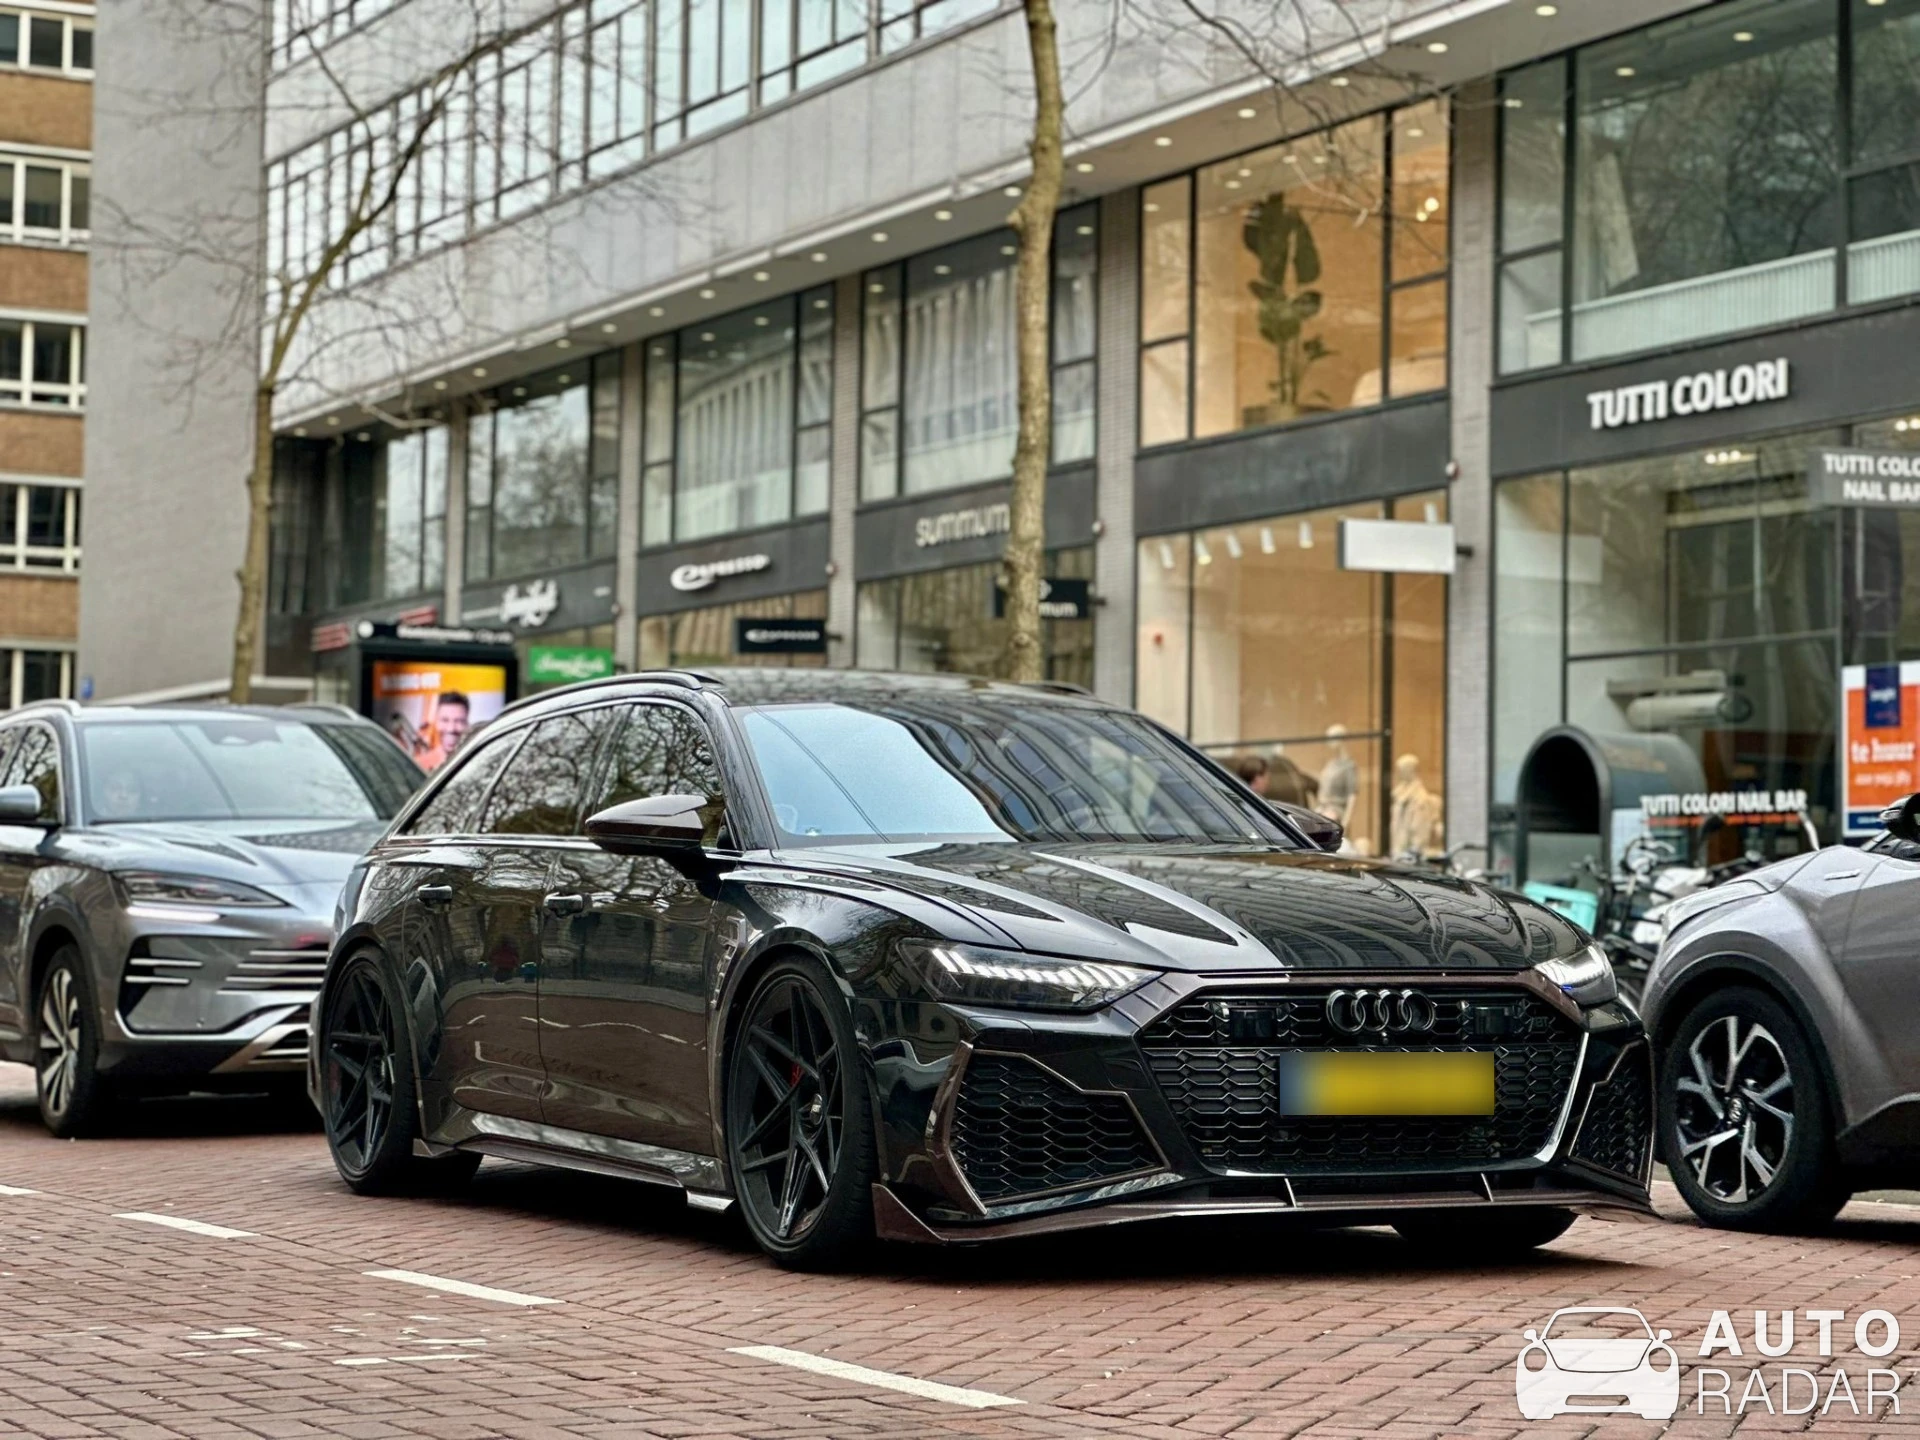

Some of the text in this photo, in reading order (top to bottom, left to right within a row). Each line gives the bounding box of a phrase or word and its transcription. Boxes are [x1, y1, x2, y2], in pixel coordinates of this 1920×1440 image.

[1587, 357, 1787, 429] TUTTI COLORI
[1822, 453, 1874, 475] TUTTI
[1843, 480, 1886, 501] NAIL
[1640, 789, 1807, 815] TUTTI COLORI NAIL BAR
